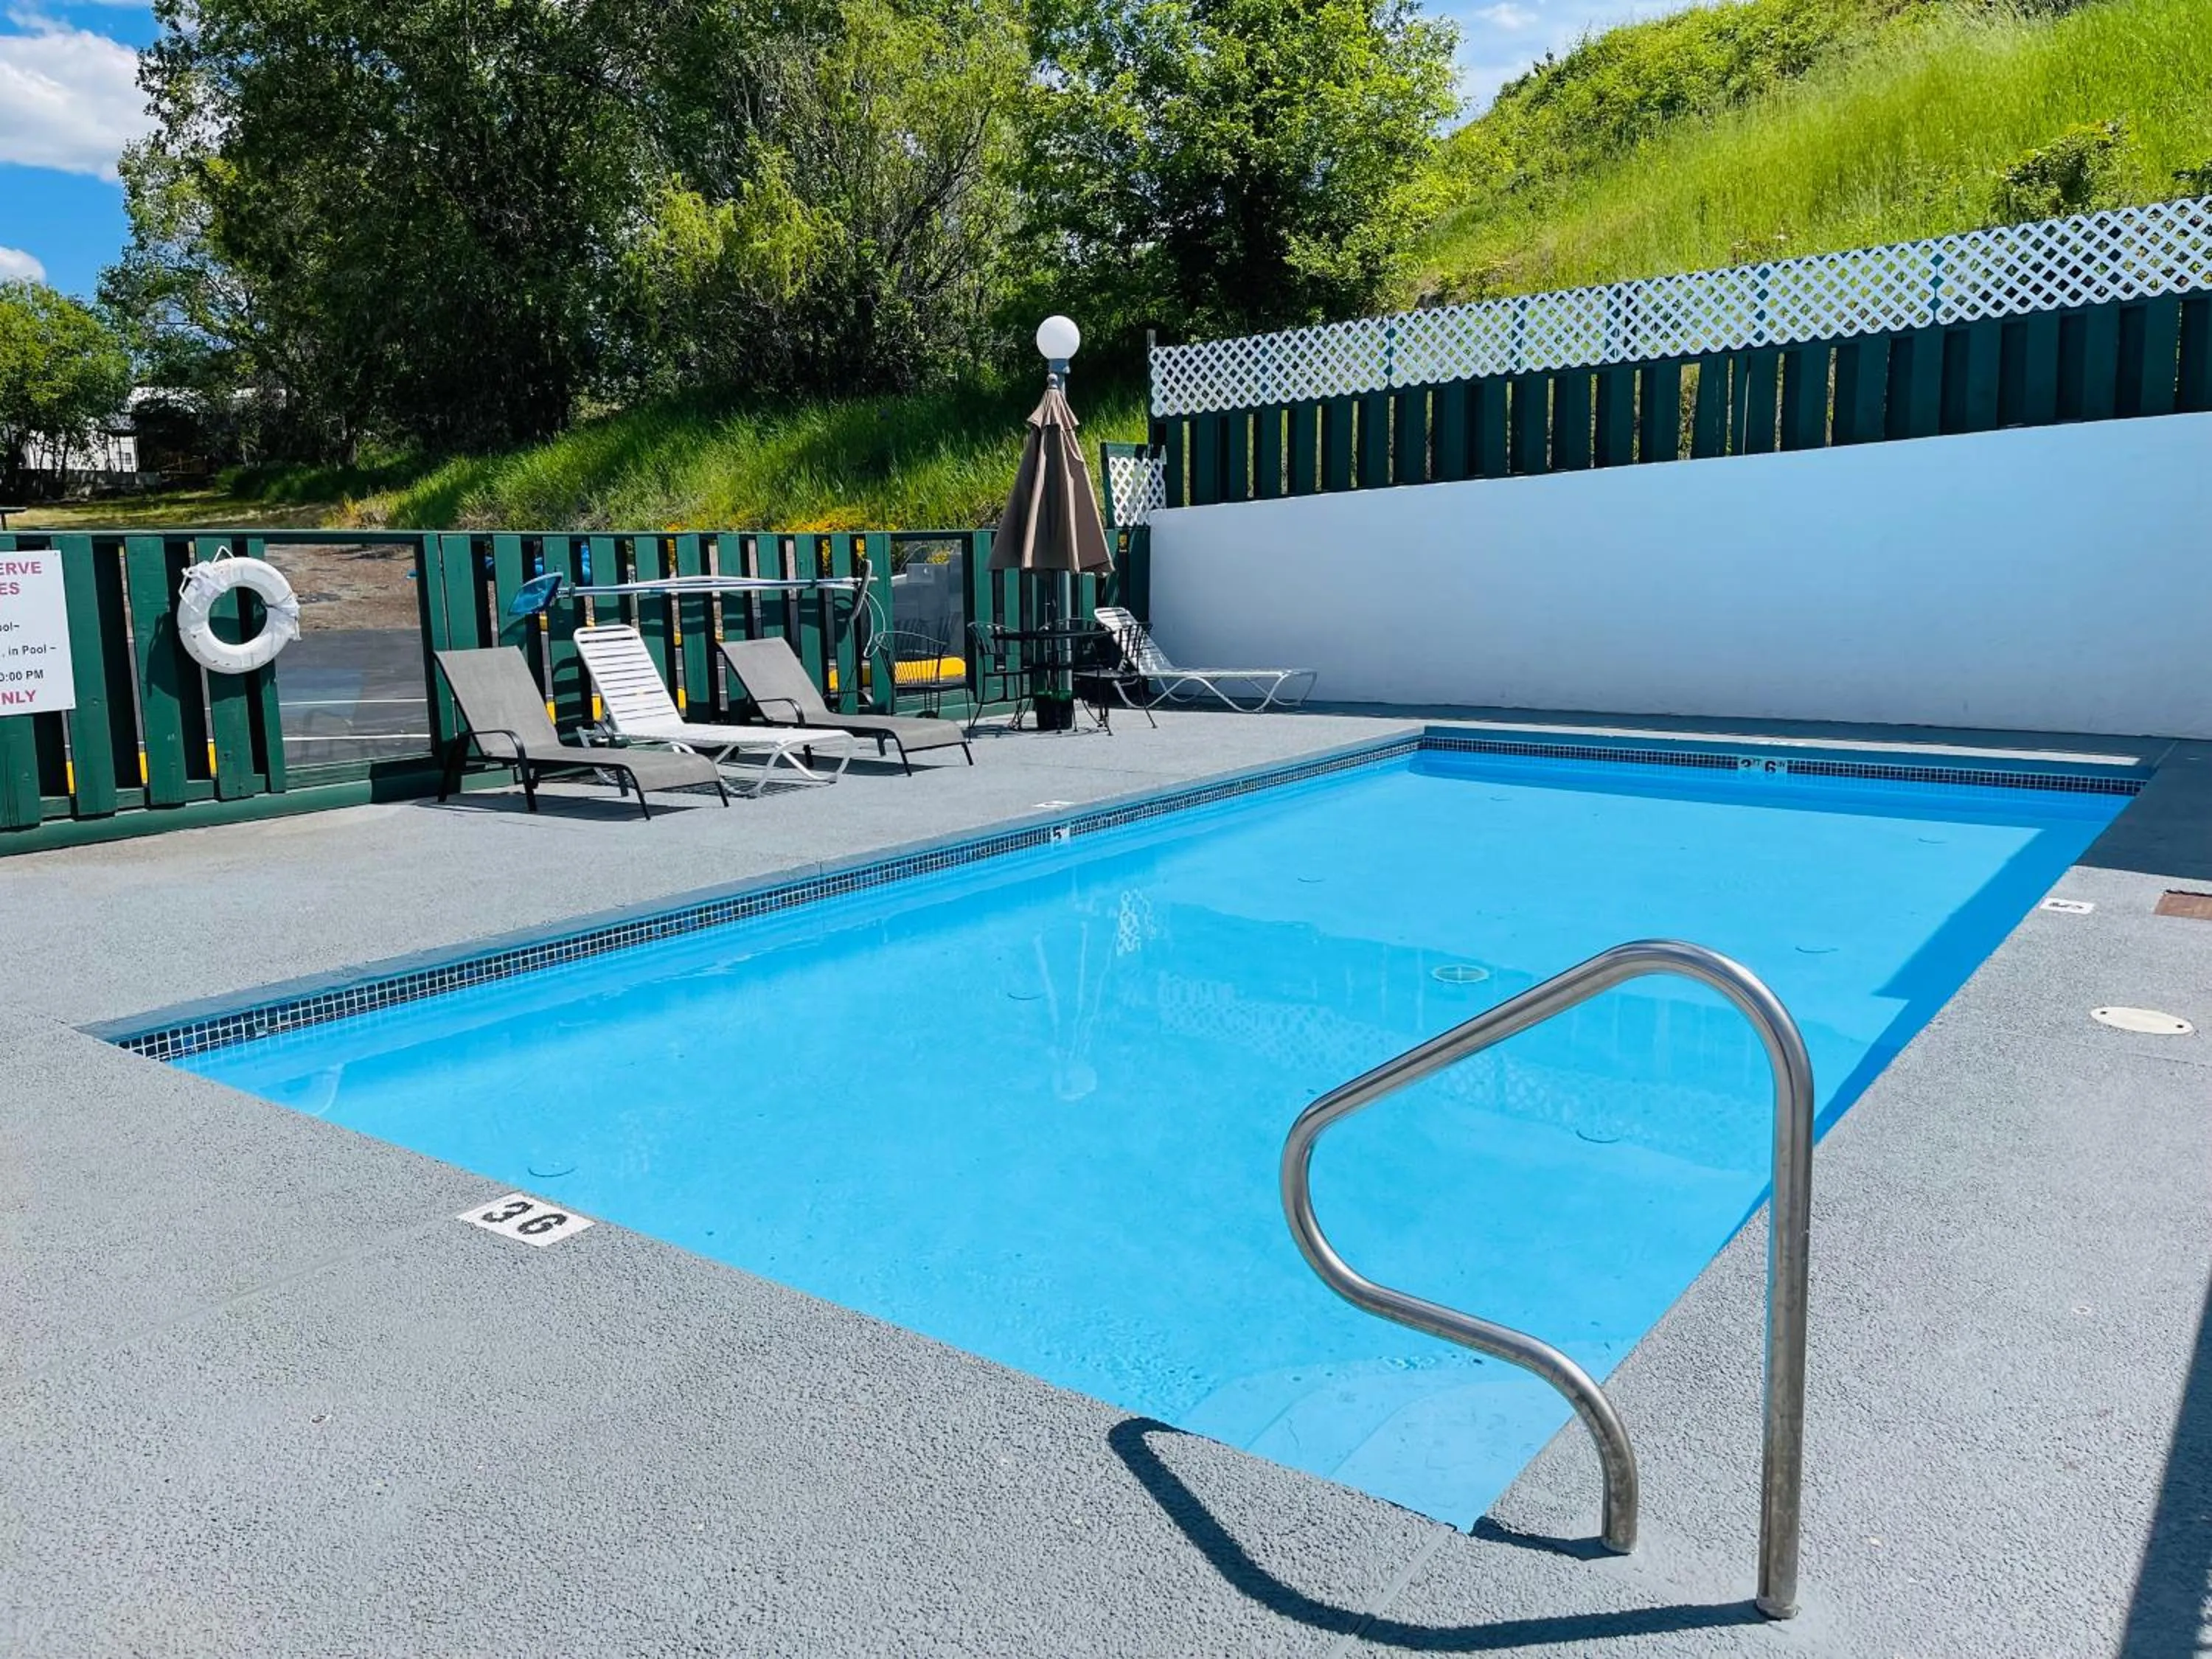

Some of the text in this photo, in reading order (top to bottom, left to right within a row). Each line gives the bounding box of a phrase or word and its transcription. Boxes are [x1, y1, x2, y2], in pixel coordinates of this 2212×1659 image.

[8, 646, 18, 655] in
[22, 644, 46, 655] Pool
[26, 669, 44, 679] PM
